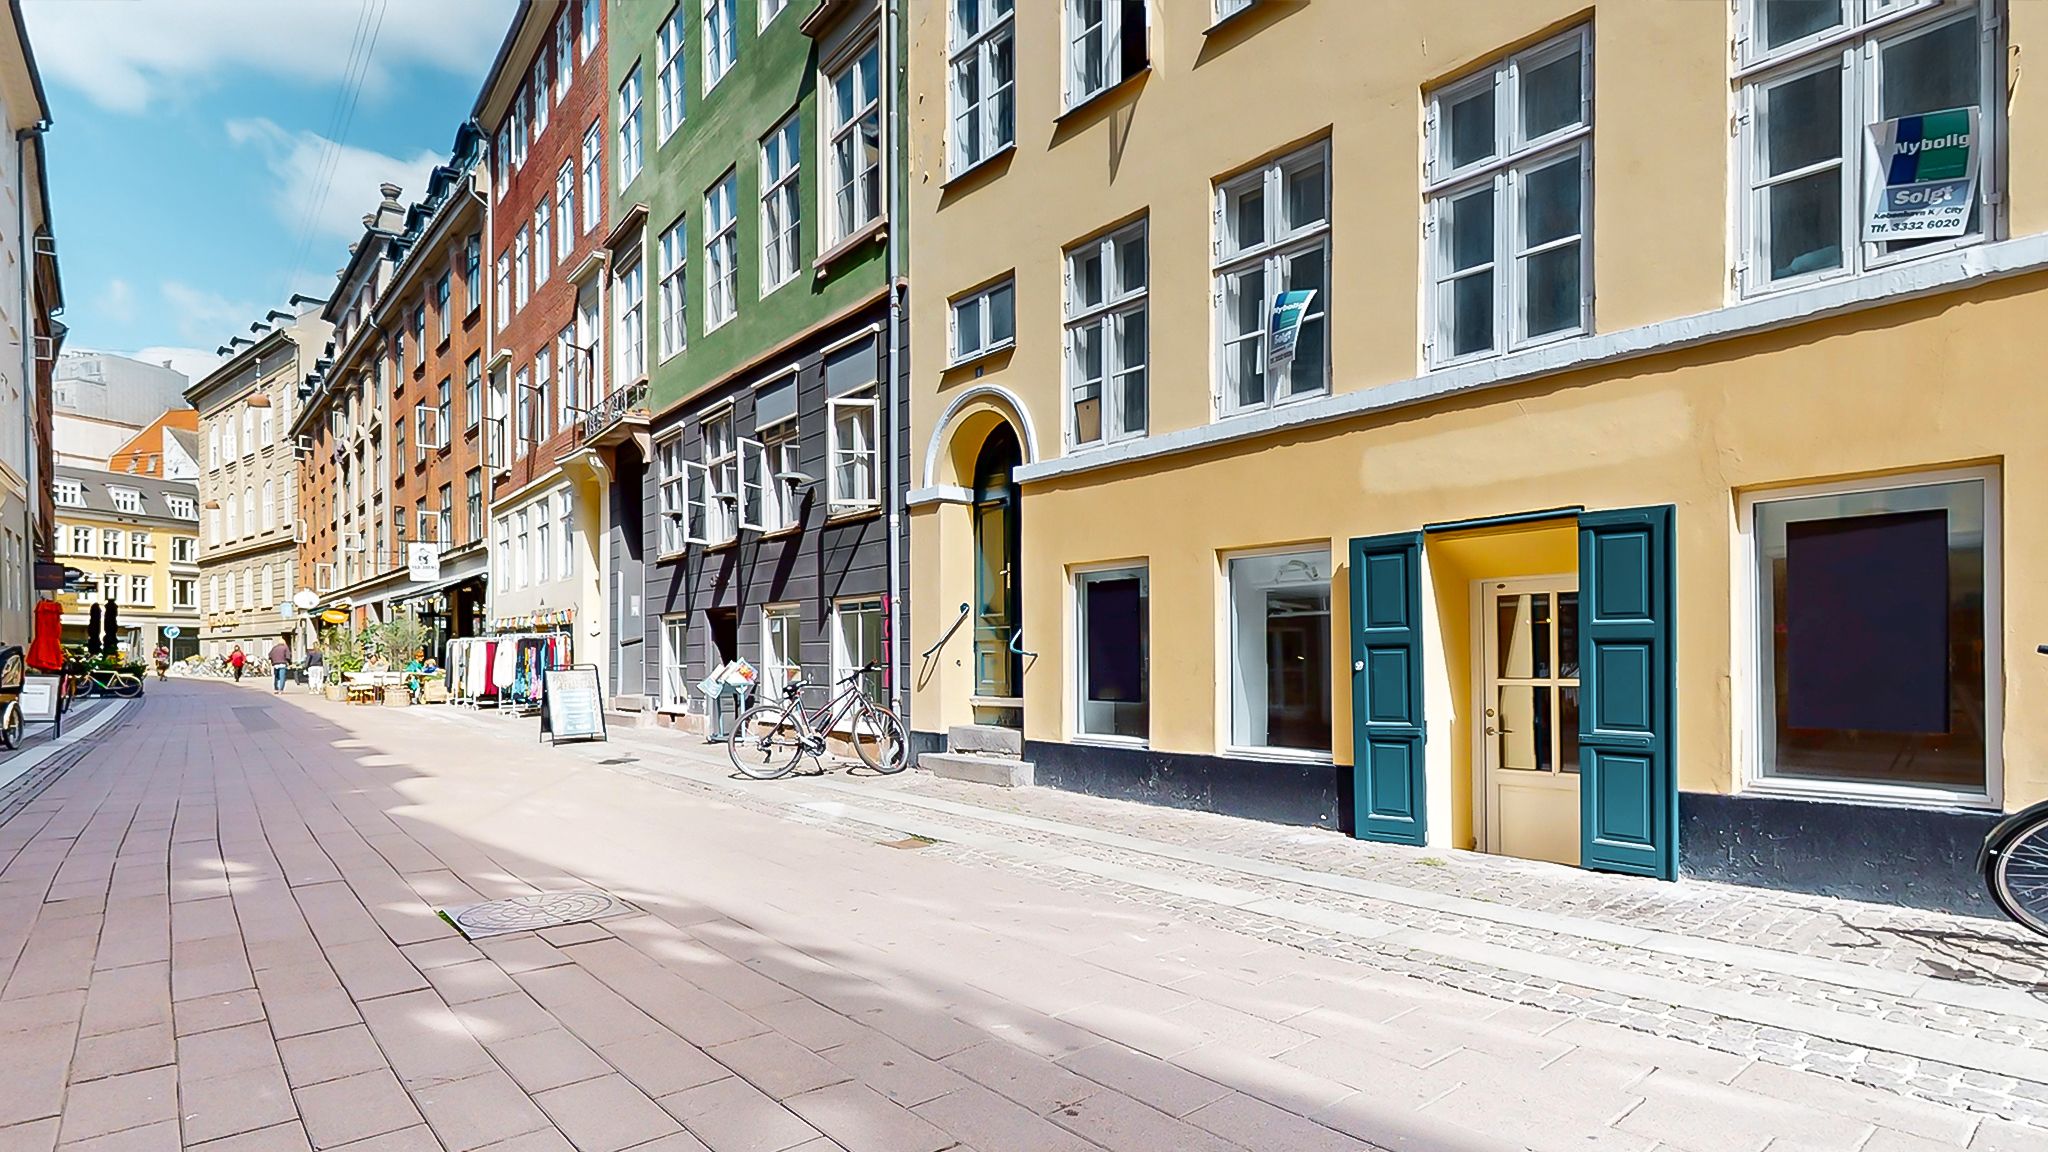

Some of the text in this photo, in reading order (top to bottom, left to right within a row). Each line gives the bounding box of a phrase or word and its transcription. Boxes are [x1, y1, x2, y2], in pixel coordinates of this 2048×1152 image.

[1895, 133, 1970, 156] Nybolig
[1894, 185, 1953, 205] Solgt
[1873, 210, 1926, 219] København
[1927, 208, 1935, 216] K
[1944, 206, 1965, 215] City
[1870, 218, 1960, 233] Tlf. 3332 6020
